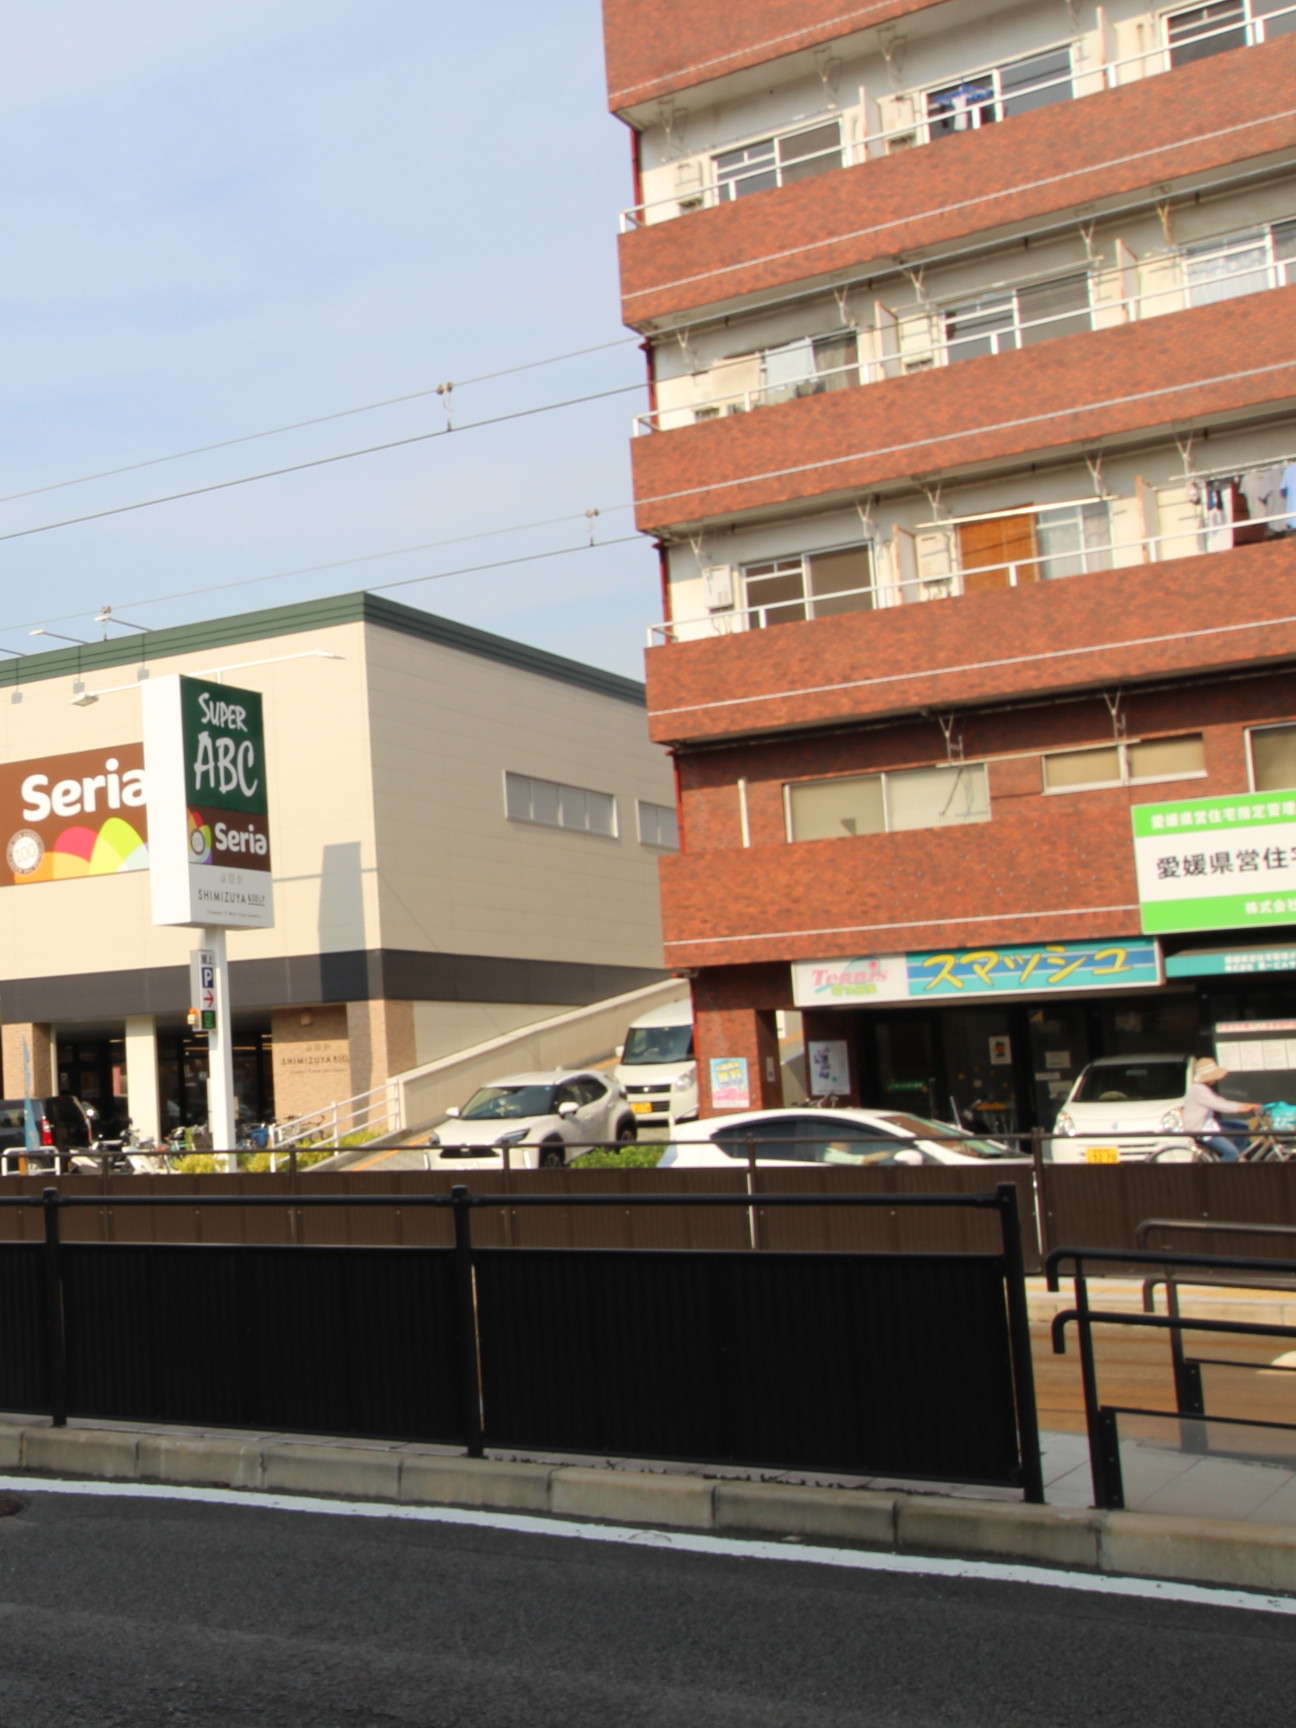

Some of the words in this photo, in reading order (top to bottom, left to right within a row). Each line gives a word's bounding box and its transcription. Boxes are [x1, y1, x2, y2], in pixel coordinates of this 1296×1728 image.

[198, 692, 248, 733] SUPER
[194, 731, 258, 797] ABC
[21, 758, 147, 822] Seria
[215, 822, 268, 855] Seria
[1157, 846, 1296, 880] 愛媛県営住
[198, 889, 247, 904] SHIMIZUYA
[204, 969, 212, 987] P
[812, 961, 888, 986] Tennis
[922, 945, 1133, 991] スマッシュ
